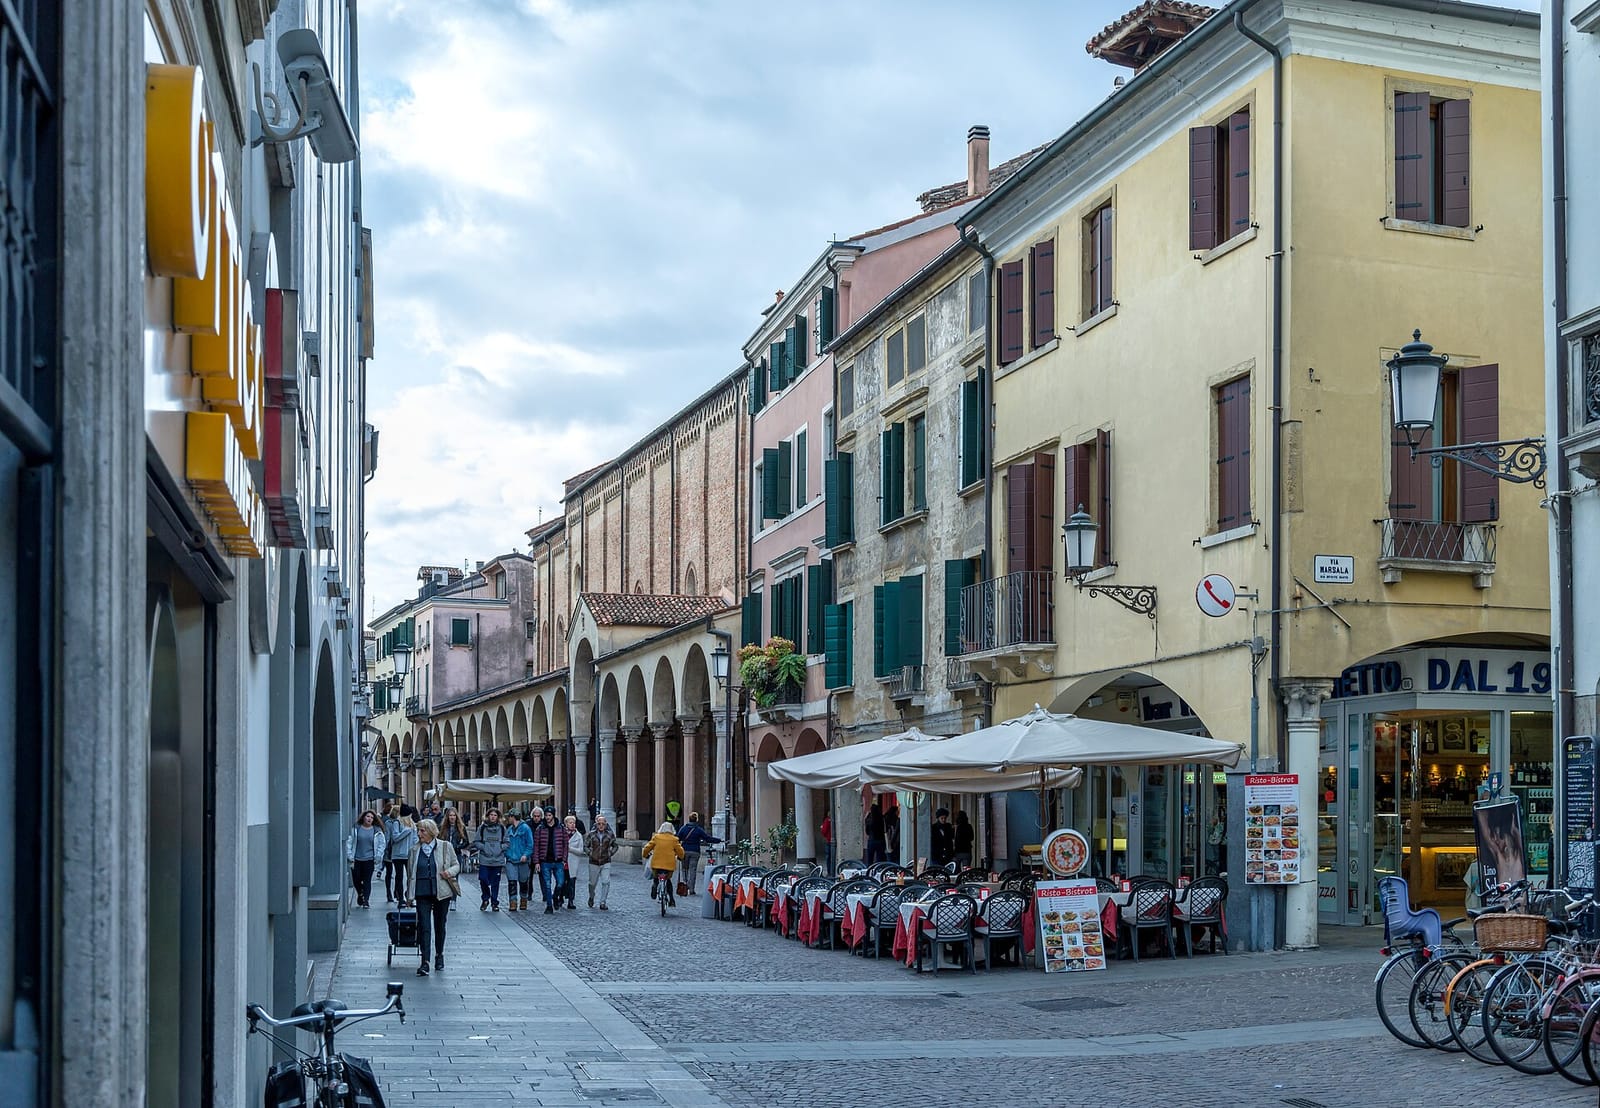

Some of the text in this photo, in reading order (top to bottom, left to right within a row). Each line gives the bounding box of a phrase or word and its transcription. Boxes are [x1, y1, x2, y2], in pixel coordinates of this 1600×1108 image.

[1319, 566, 1349, 575] MARSALA
[1428, 658, 1498, 691] DAL
[1041, 887, 1094, 897] Risto-Bistrot
